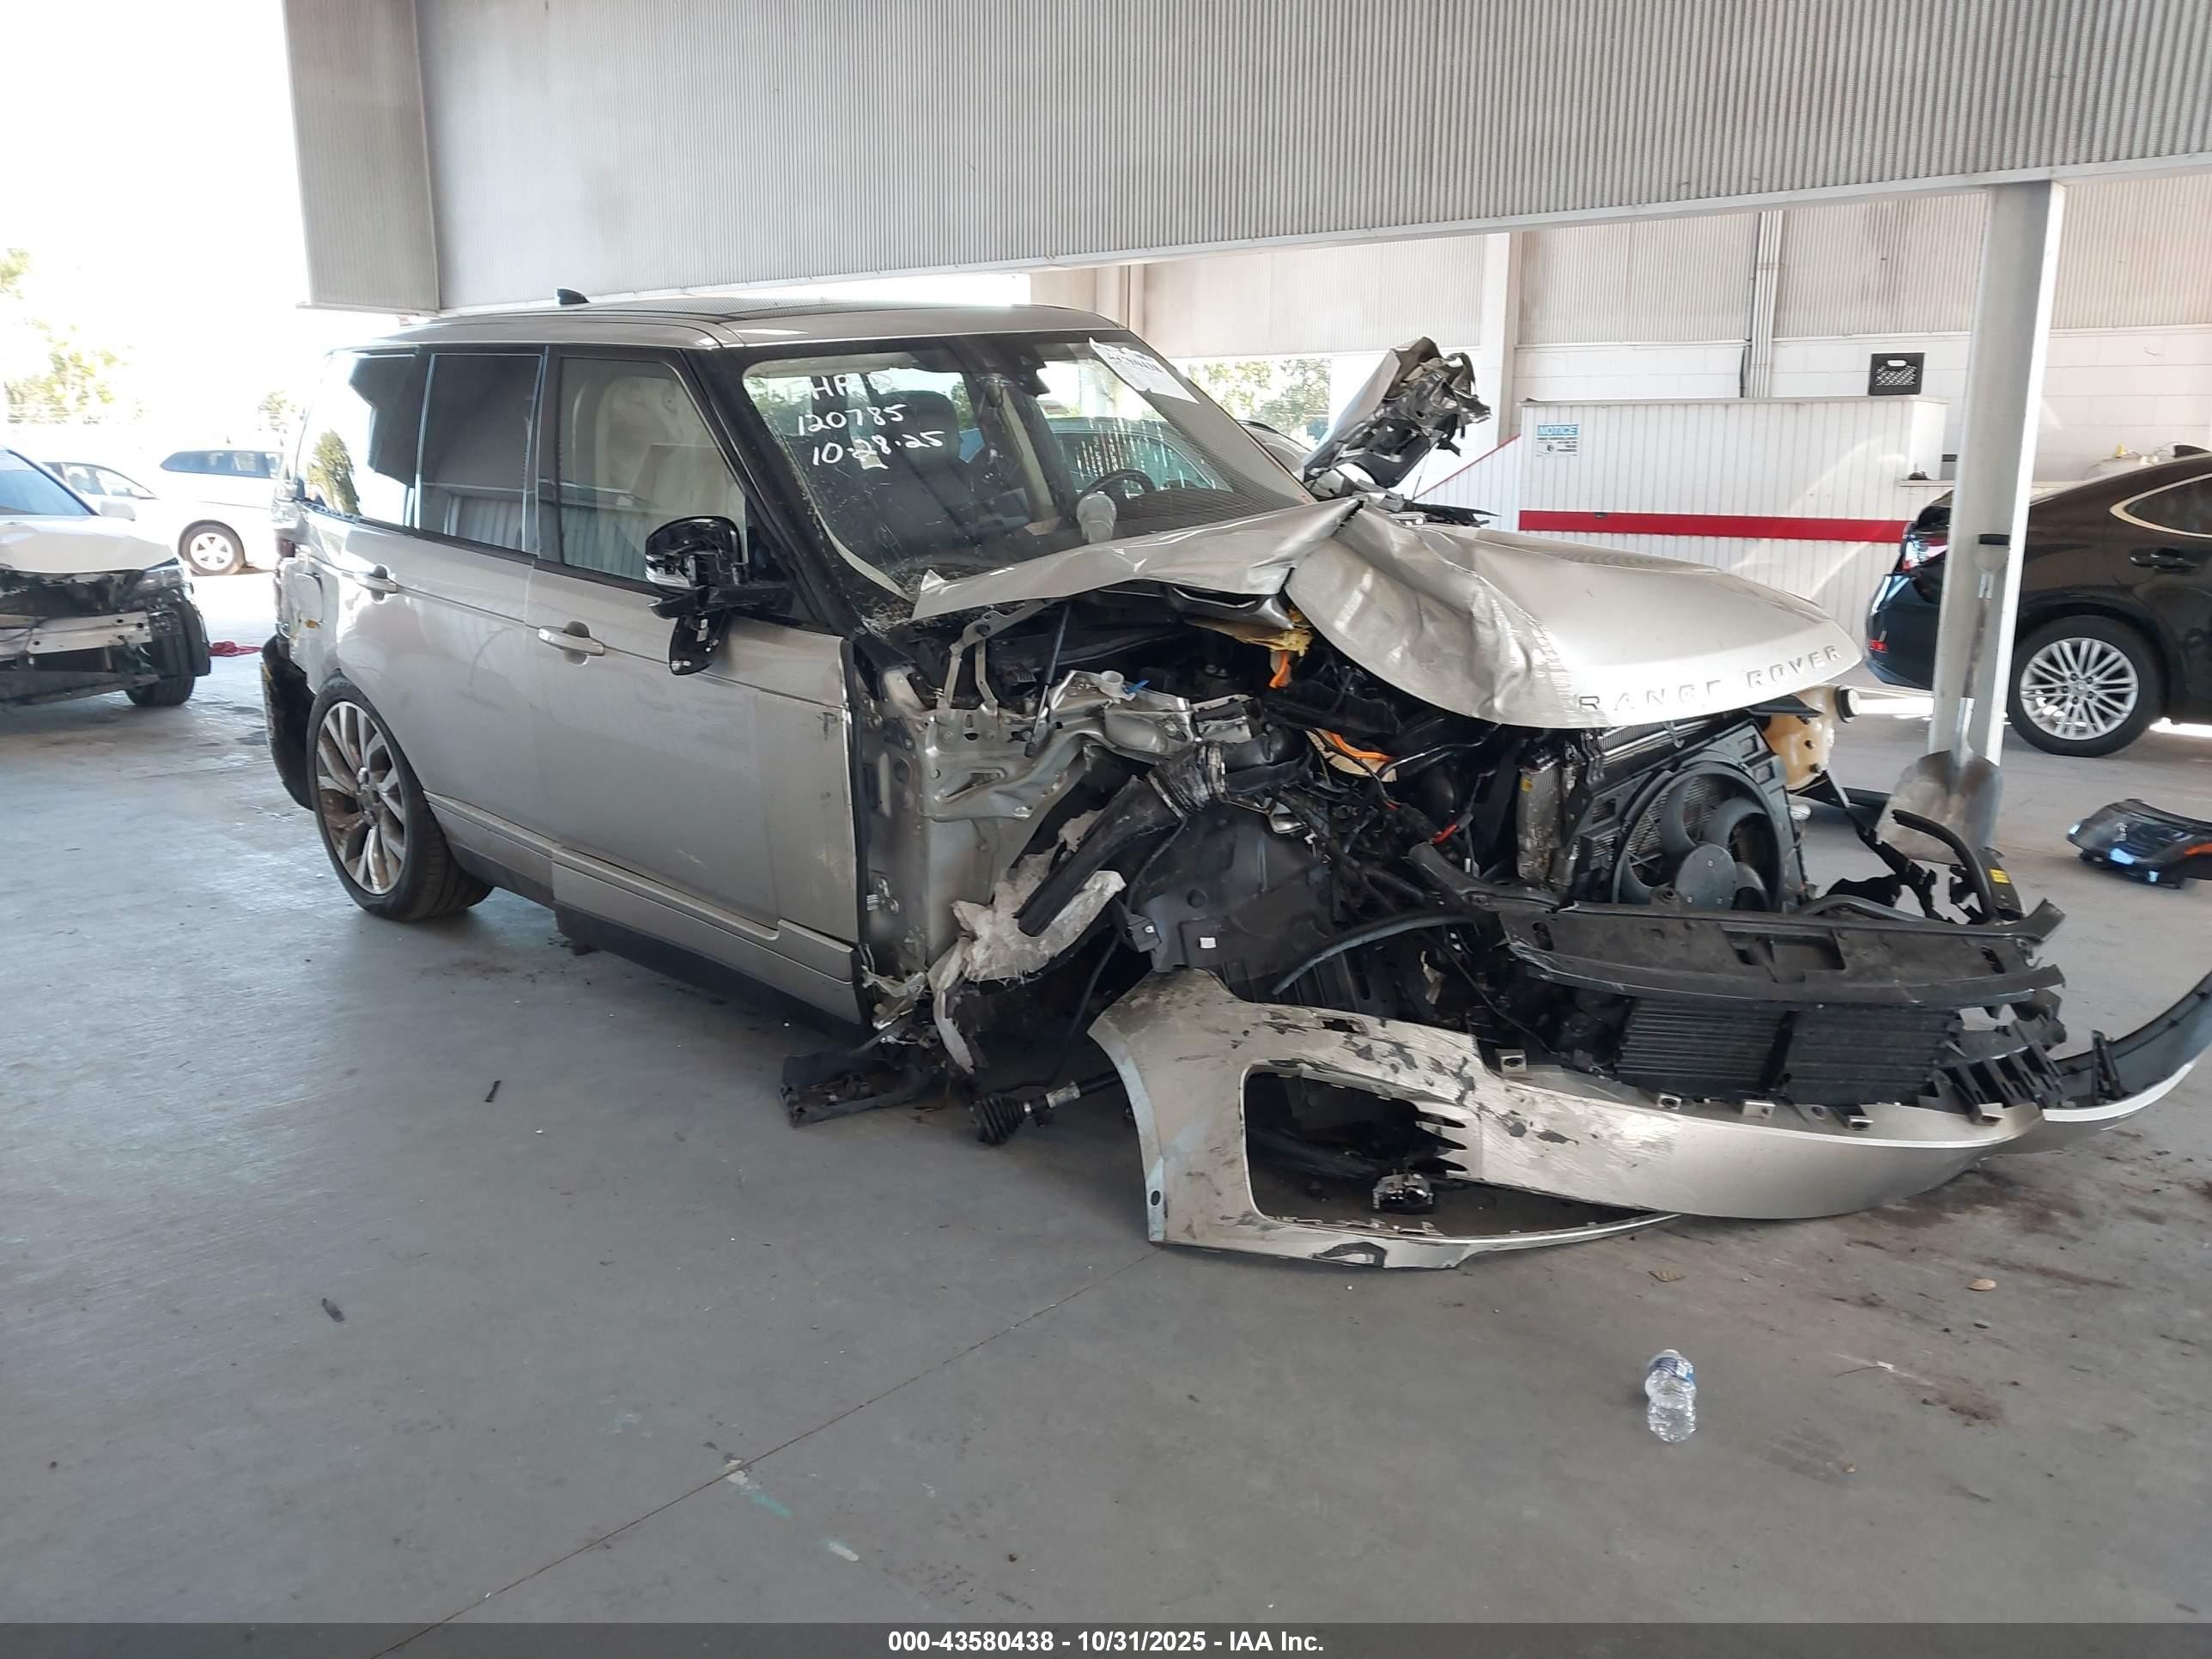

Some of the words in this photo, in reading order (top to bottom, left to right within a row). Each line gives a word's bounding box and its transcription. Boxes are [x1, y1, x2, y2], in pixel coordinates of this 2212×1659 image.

[798, 404, 908, 436] 120785
[1539, 426, 1577, 435] NOTICE
[1577, 679, 1721, 711] RANGE
[1747, 644, 1842, 689] ROVER
